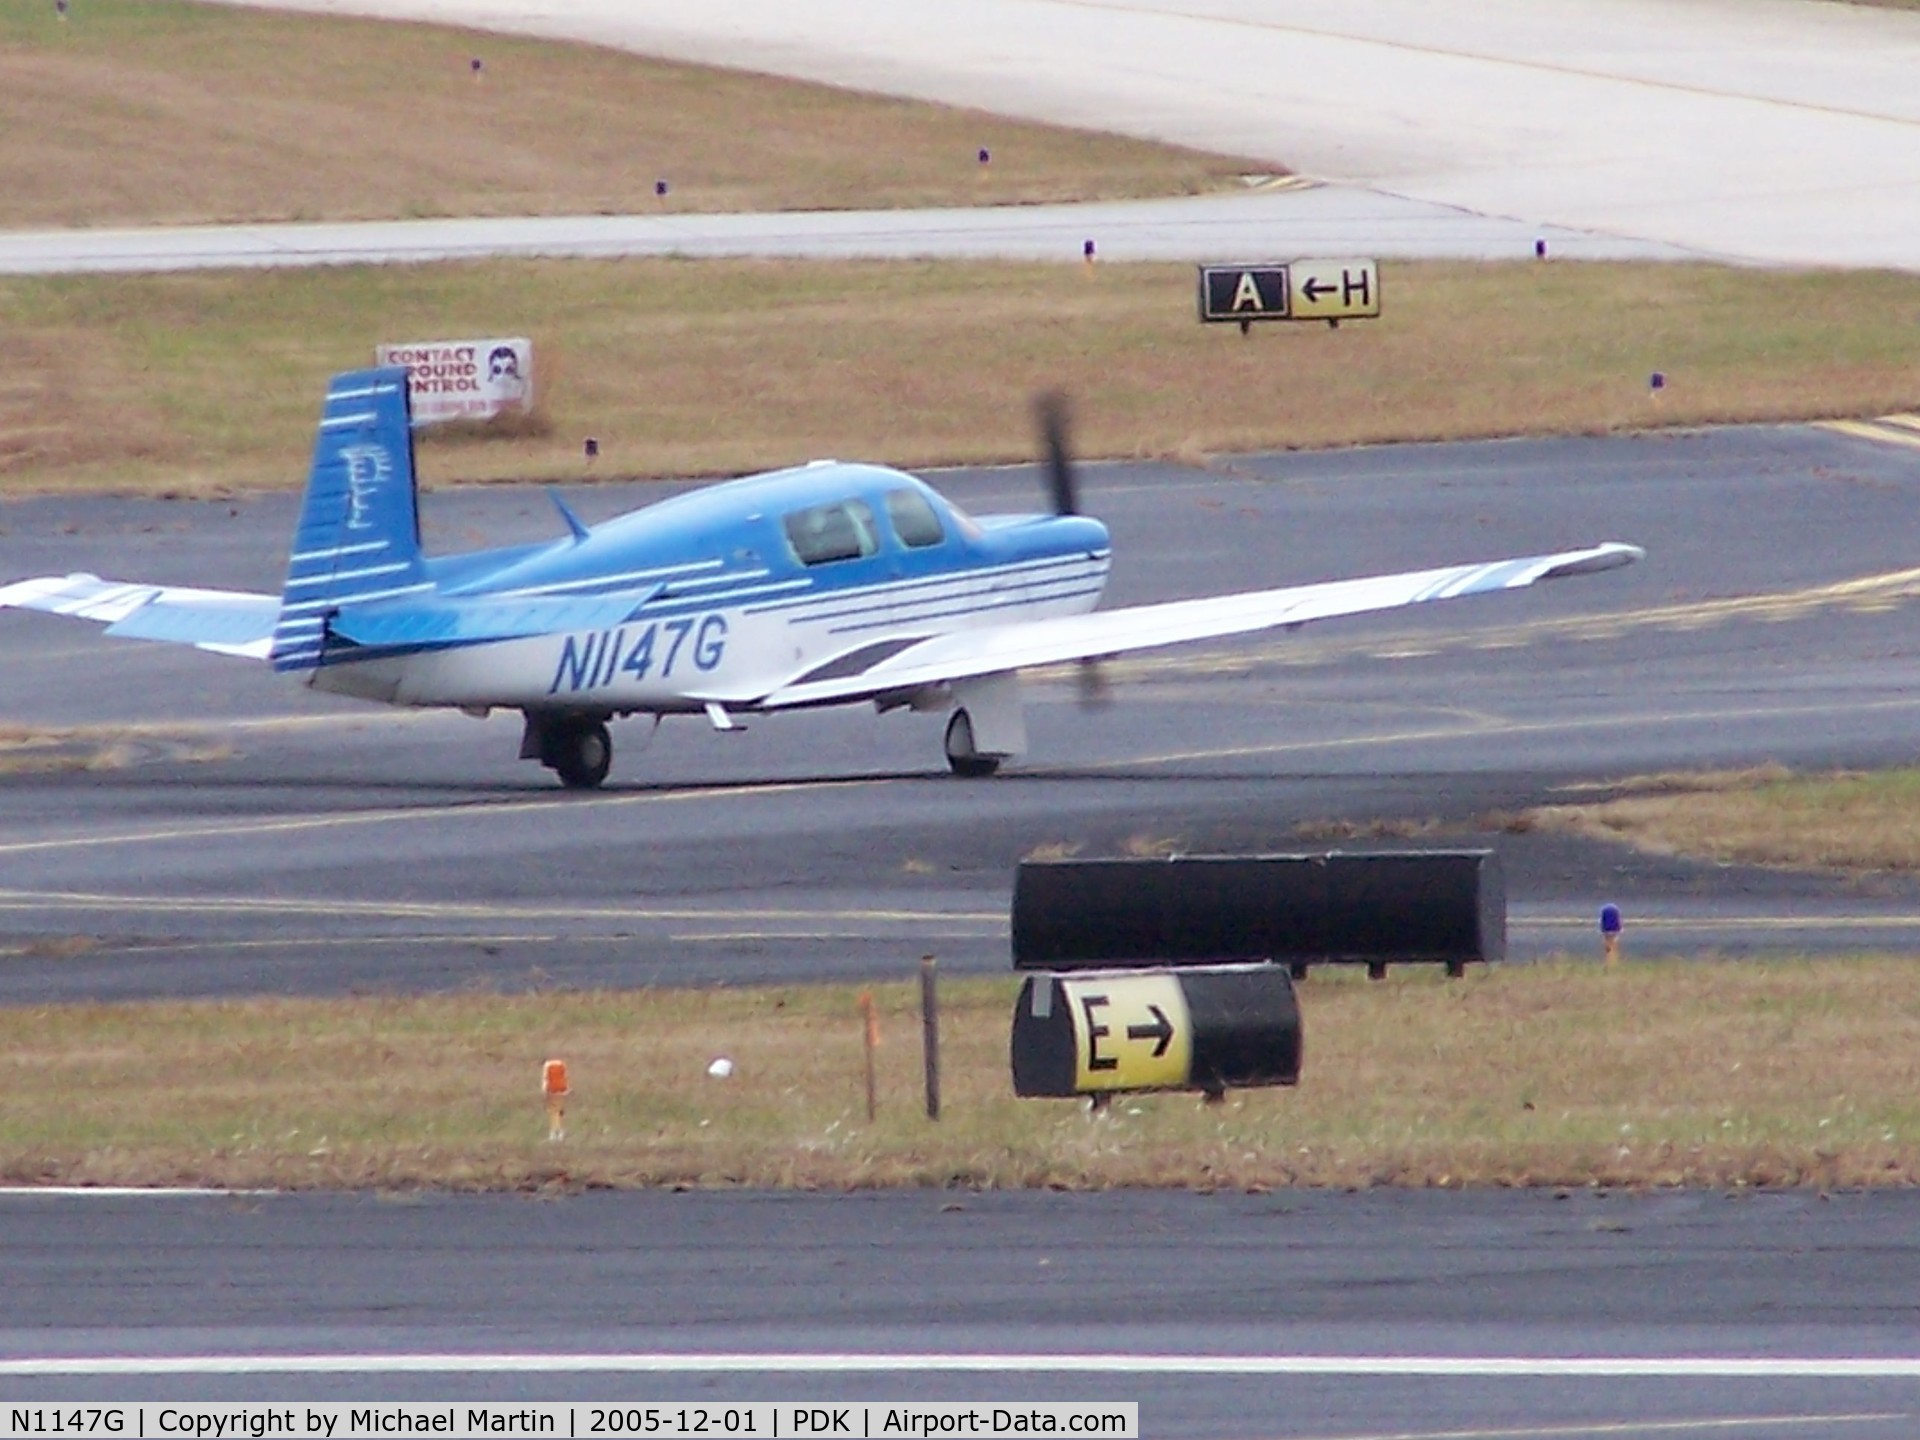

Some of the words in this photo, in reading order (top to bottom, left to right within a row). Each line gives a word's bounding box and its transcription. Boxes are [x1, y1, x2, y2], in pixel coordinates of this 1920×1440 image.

[1232, 272, 1263, 311] A
[1343, 269, 1369, 306] H
[389, 348, 475, 364] CONTACT
[408, 364, 476, 377] ROUND
[410, 379, 480, 392] NTROL
[548, 614, 728, 694] N1147G
[1082, 996, 1118, 1070] E
